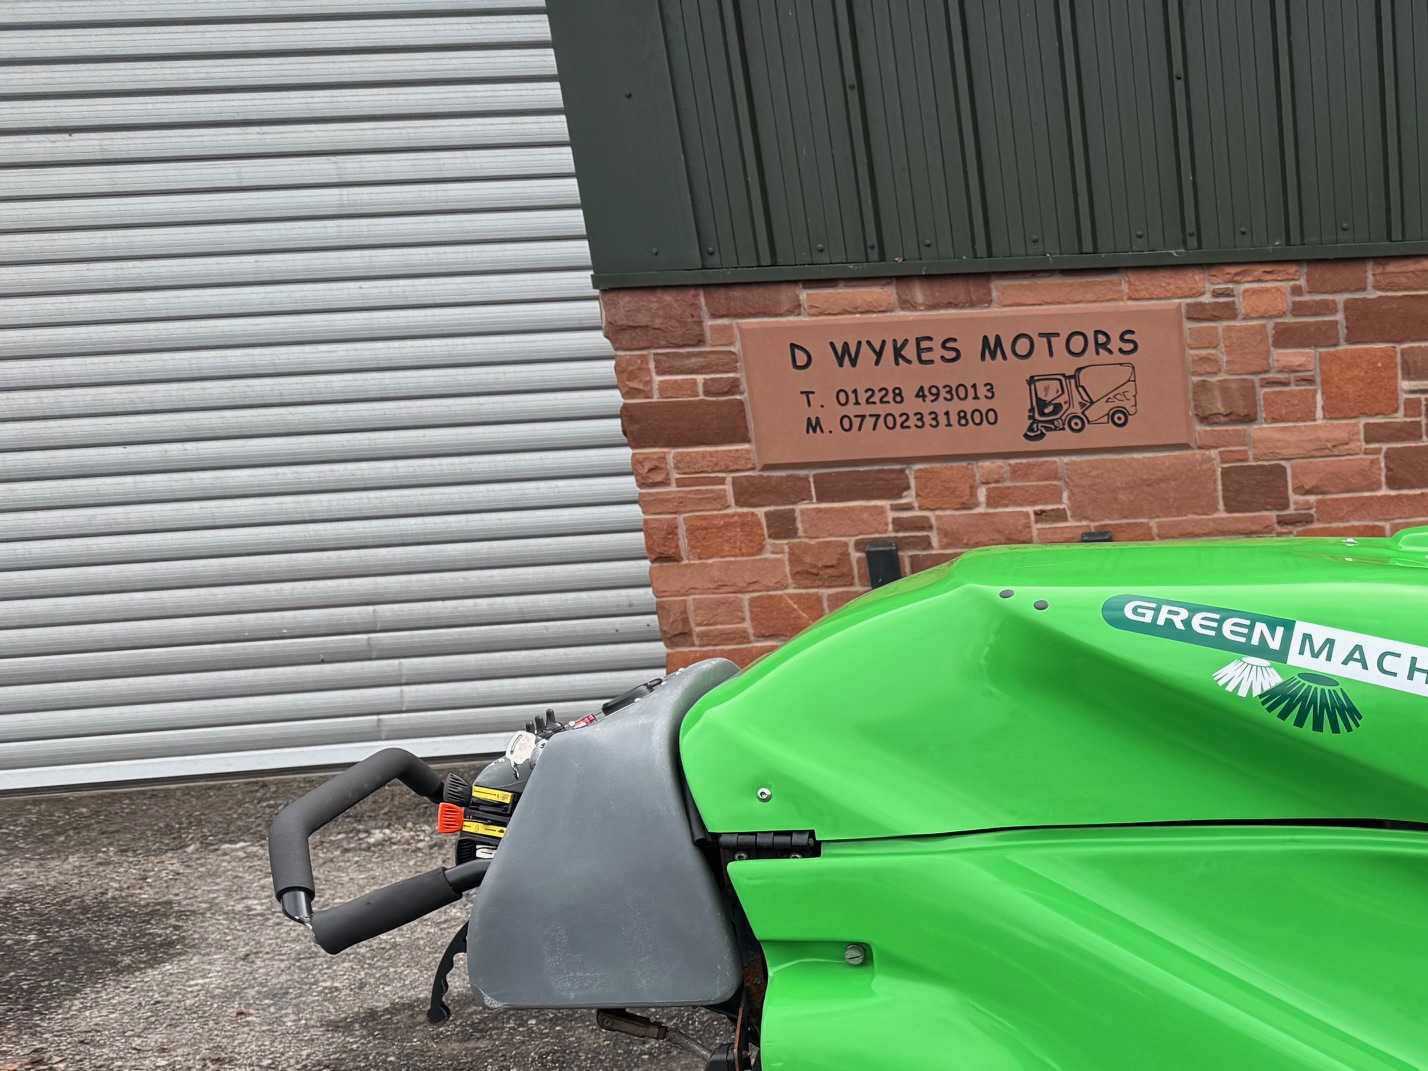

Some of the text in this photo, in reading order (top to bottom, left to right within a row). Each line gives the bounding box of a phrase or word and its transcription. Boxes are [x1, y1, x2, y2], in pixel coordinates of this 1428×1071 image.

[789, 329, 1139, 370] D WYKES MOTORS
[800, 382, 996, 408] T. 01228 493013
[1123, 599, 1286, 651] GREEN
